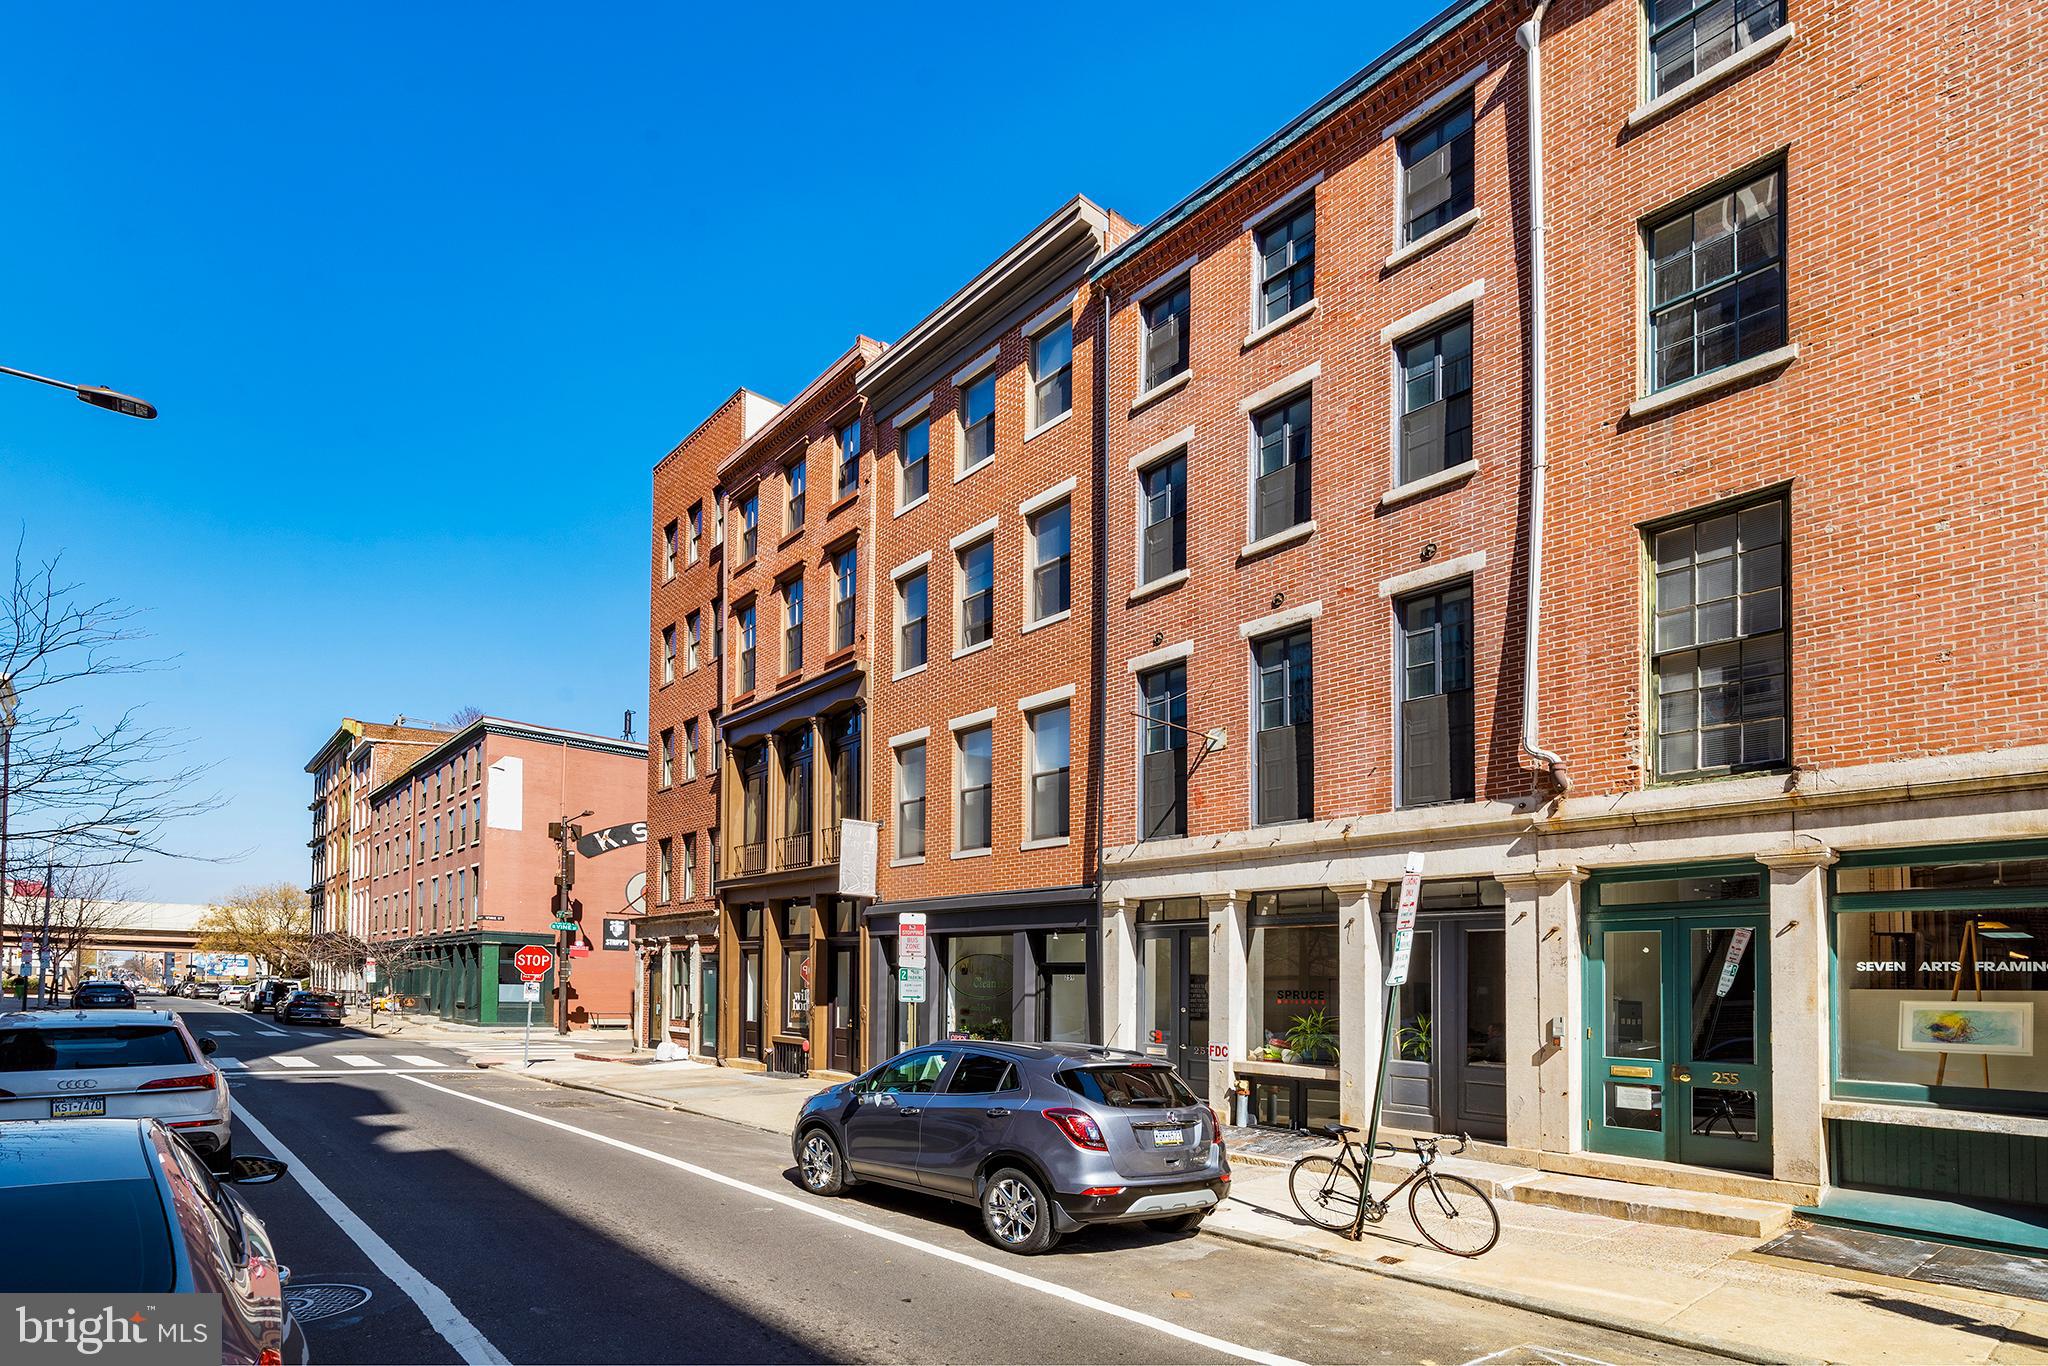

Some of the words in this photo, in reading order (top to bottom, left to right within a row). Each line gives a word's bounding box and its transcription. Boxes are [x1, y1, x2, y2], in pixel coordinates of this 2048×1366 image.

[517, 954, 550, 967] STOP
[1856, 961, 1907, 972] SEVEN
[1918, 961, 1962, 972] ARTS
[1974, 961, 2048, 972] FRAMIN
[901, 970, 907, 980] 2
[1277, 990, 1325, 1000] SPRUCE
[1193, 1046, 1208, 1055] 25
[1209, 1045, 1229, 1057] FDC
[1711, 1071, 1739, 1085] 255
[54, 1100, 103, 1112] KST-7470
